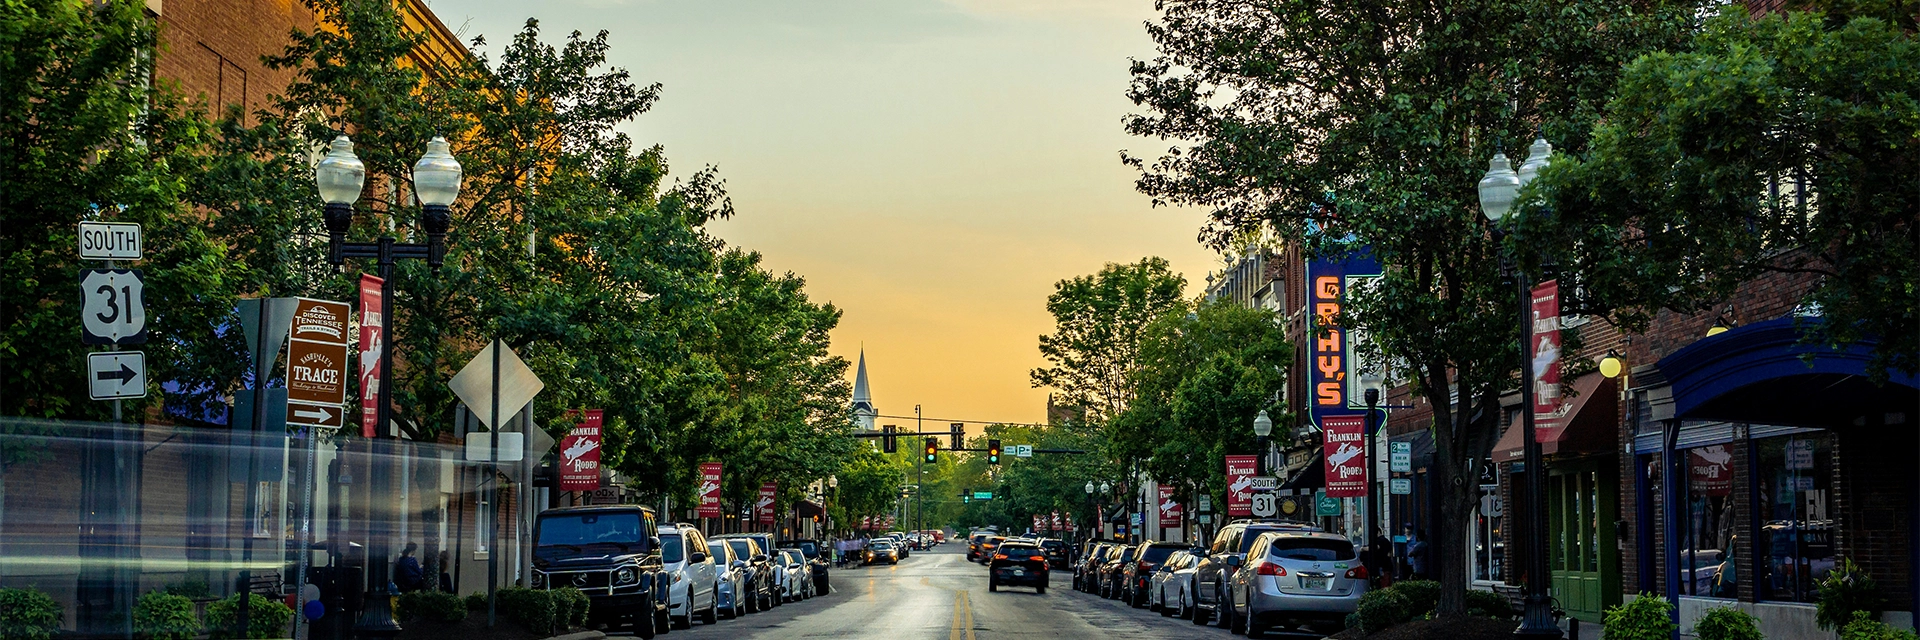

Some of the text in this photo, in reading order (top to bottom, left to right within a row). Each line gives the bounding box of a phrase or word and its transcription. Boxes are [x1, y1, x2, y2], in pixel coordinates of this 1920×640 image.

[84, 230, 137, 251] SOUTH
[96, 284, 133, 324] 31
[295, 315, 343, 330] TENNESSEE
[302, 311, 337, 321] DISCOVER
[1316, 276, 1346, 405] GRAY'S
[300, 352, 333, 368] NASHVILLE'S
[293, 365, 339, 384] TRACE
[570, 427, 599, 436] RANKLIN
[1326, 429, 1362, 443] FRANKLIN
[574, 458, 598, 473] RODEO
[1229, 464, 1255, 476] FRANKLIN
[1340, 465, 1363, 479] RODEO
[1252, 479, 1275, 488] SOUTH
[1256, 497, 1271, 512] 31
[1807, 533, 1828, 543] BANK
